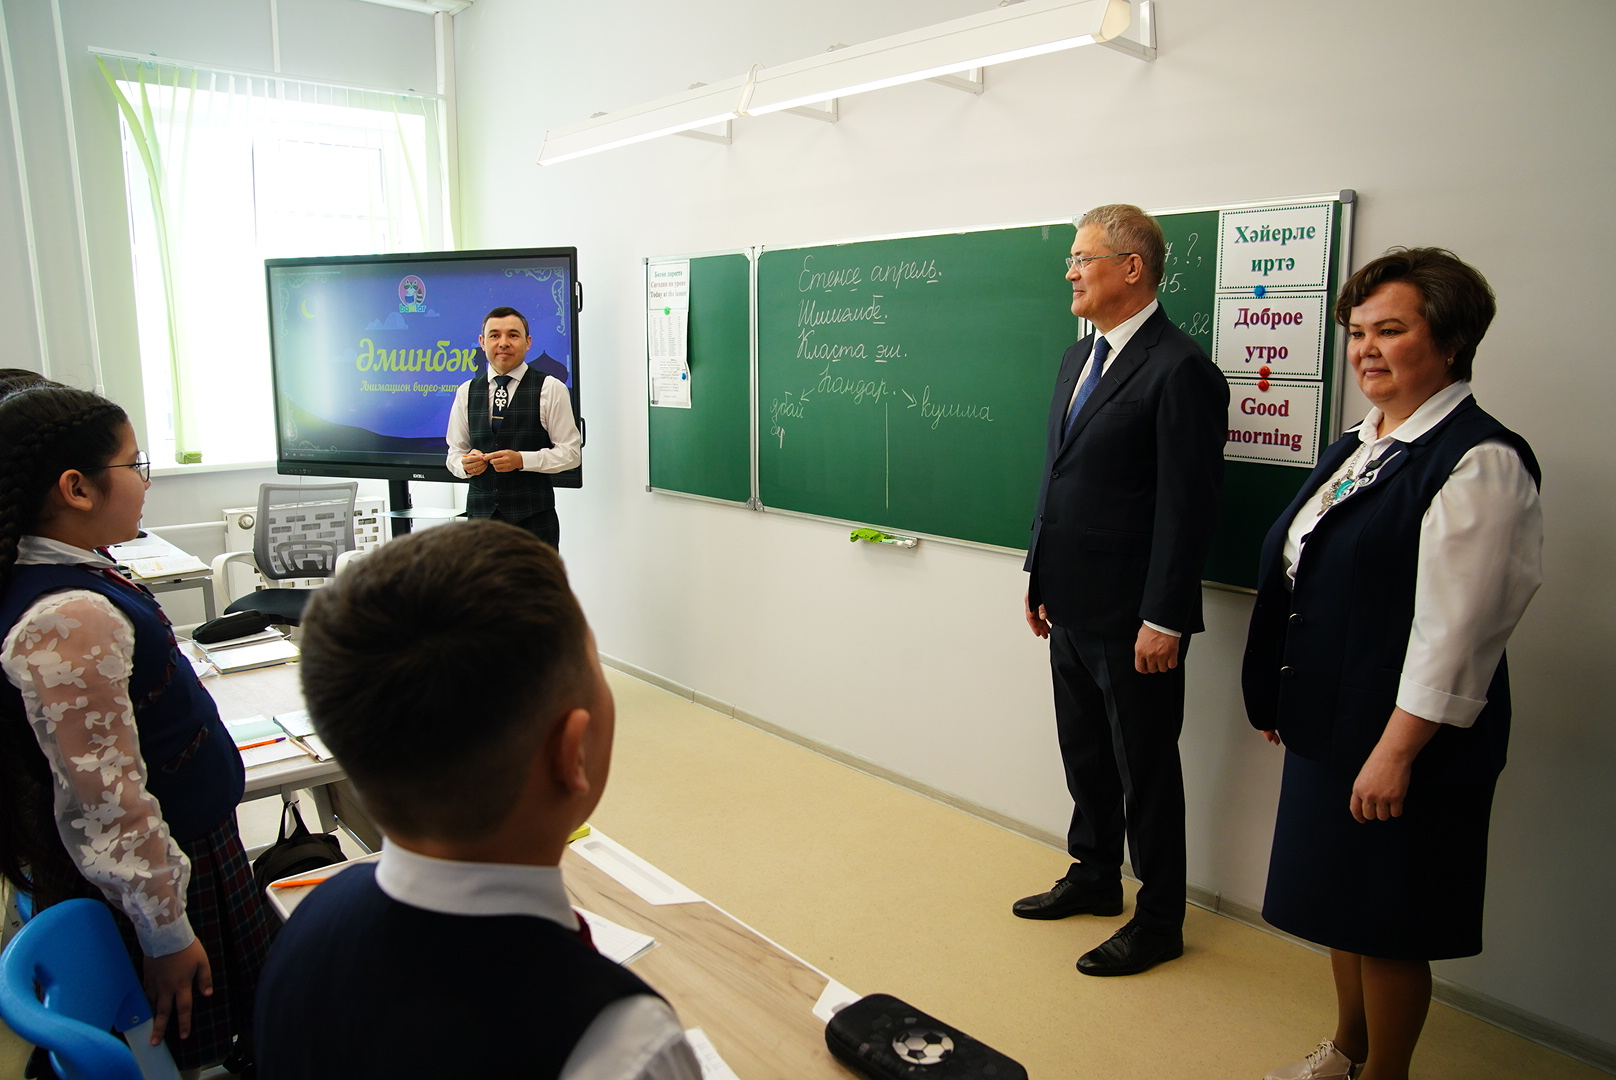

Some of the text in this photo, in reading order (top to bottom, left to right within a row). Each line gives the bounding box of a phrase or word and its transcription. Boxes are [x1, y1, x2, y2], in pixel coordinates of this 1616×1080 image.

[1234, 224, 1317, 245] Хәйерле
[799, 255, 943, 292] Етенсе апрель.
[1251, 257, 1296, 277] иртә
[1233, 307, 1303, 330] Доброе
[355, 338, 479, 373] Әминбәк
[796, 327, 869, 362] Класта
[1244, 345, 1289, 364] утро
[360, 380, 411, 394] Анимацион
[1240, 397, 1290, 417] Good
[1226, 428, 1303, 451] morning
